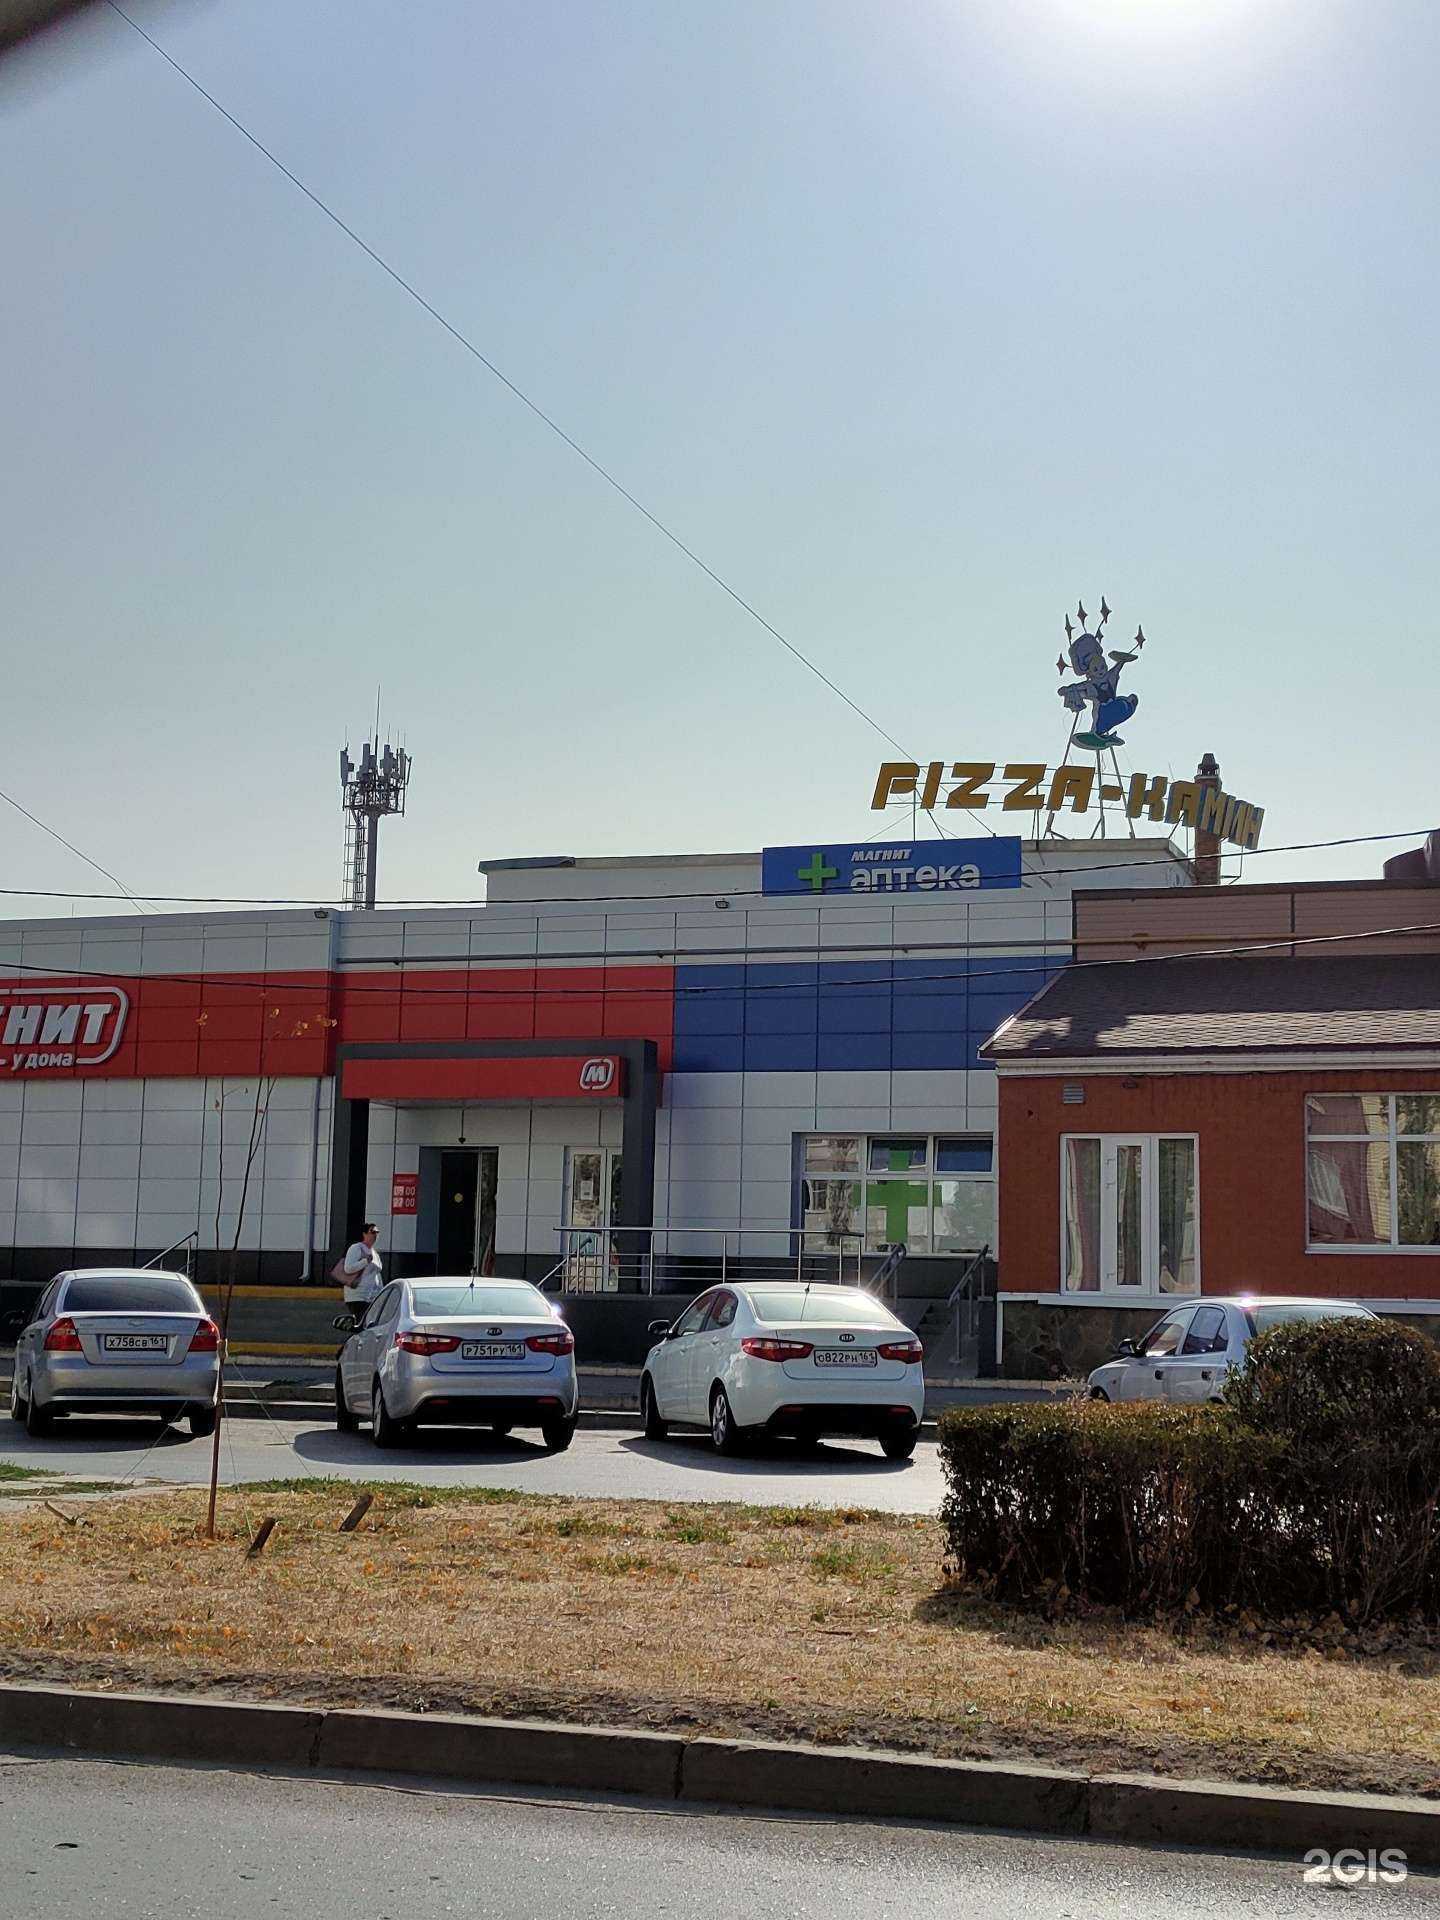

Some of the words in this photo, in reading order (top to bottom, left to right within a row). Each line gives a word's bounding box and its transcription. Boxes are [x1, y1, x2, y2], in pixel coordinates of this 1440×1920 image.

[851, 849, 912, 862] МАГНИТ
[850, 864, 980, 892] аптека
[0, 1004, 112, 1044] НИТ
[24, 1052, 74, 1069] дома
[840, 1334, 855, 1342] KIA
[507, 1344, 522, 1354] 161
